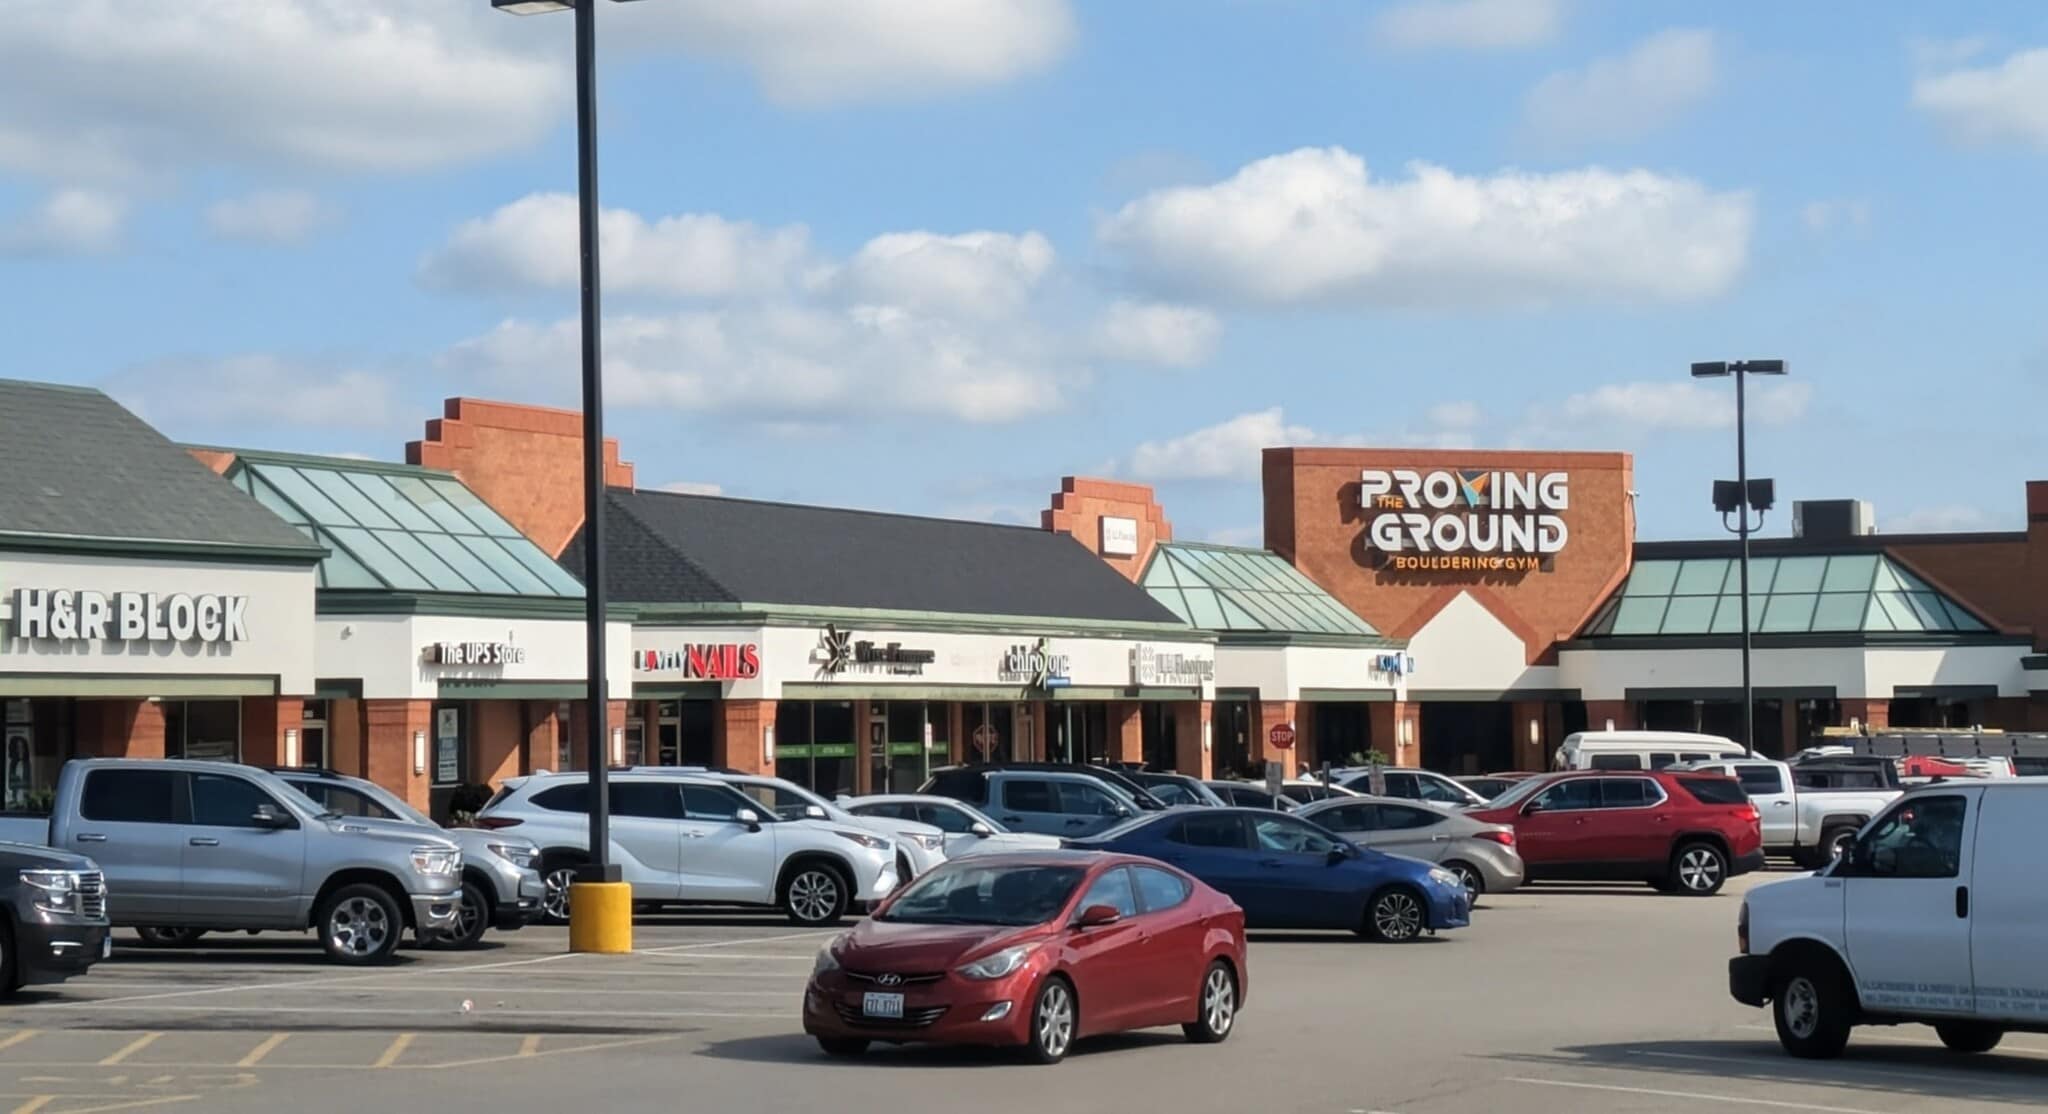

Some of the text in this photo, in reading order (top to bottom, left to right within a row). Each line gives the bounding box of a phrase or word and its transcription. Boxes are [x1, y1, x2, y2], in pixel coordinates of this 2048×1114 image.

[1361, 469, 1569, 510] PROVING
[1376, 496, 1405, 509] THE
[1371, 513, 1569, 552] GROUND
[1395, 555, 1540, 570] BOULDERING GYM
[18, 588, 249, 642] H&R BLOCK
[440, 642, 527, 665] The UPS Store
[686, 643, 760, 679] NAILS
[1271, 730, 1293, 742] STOP
